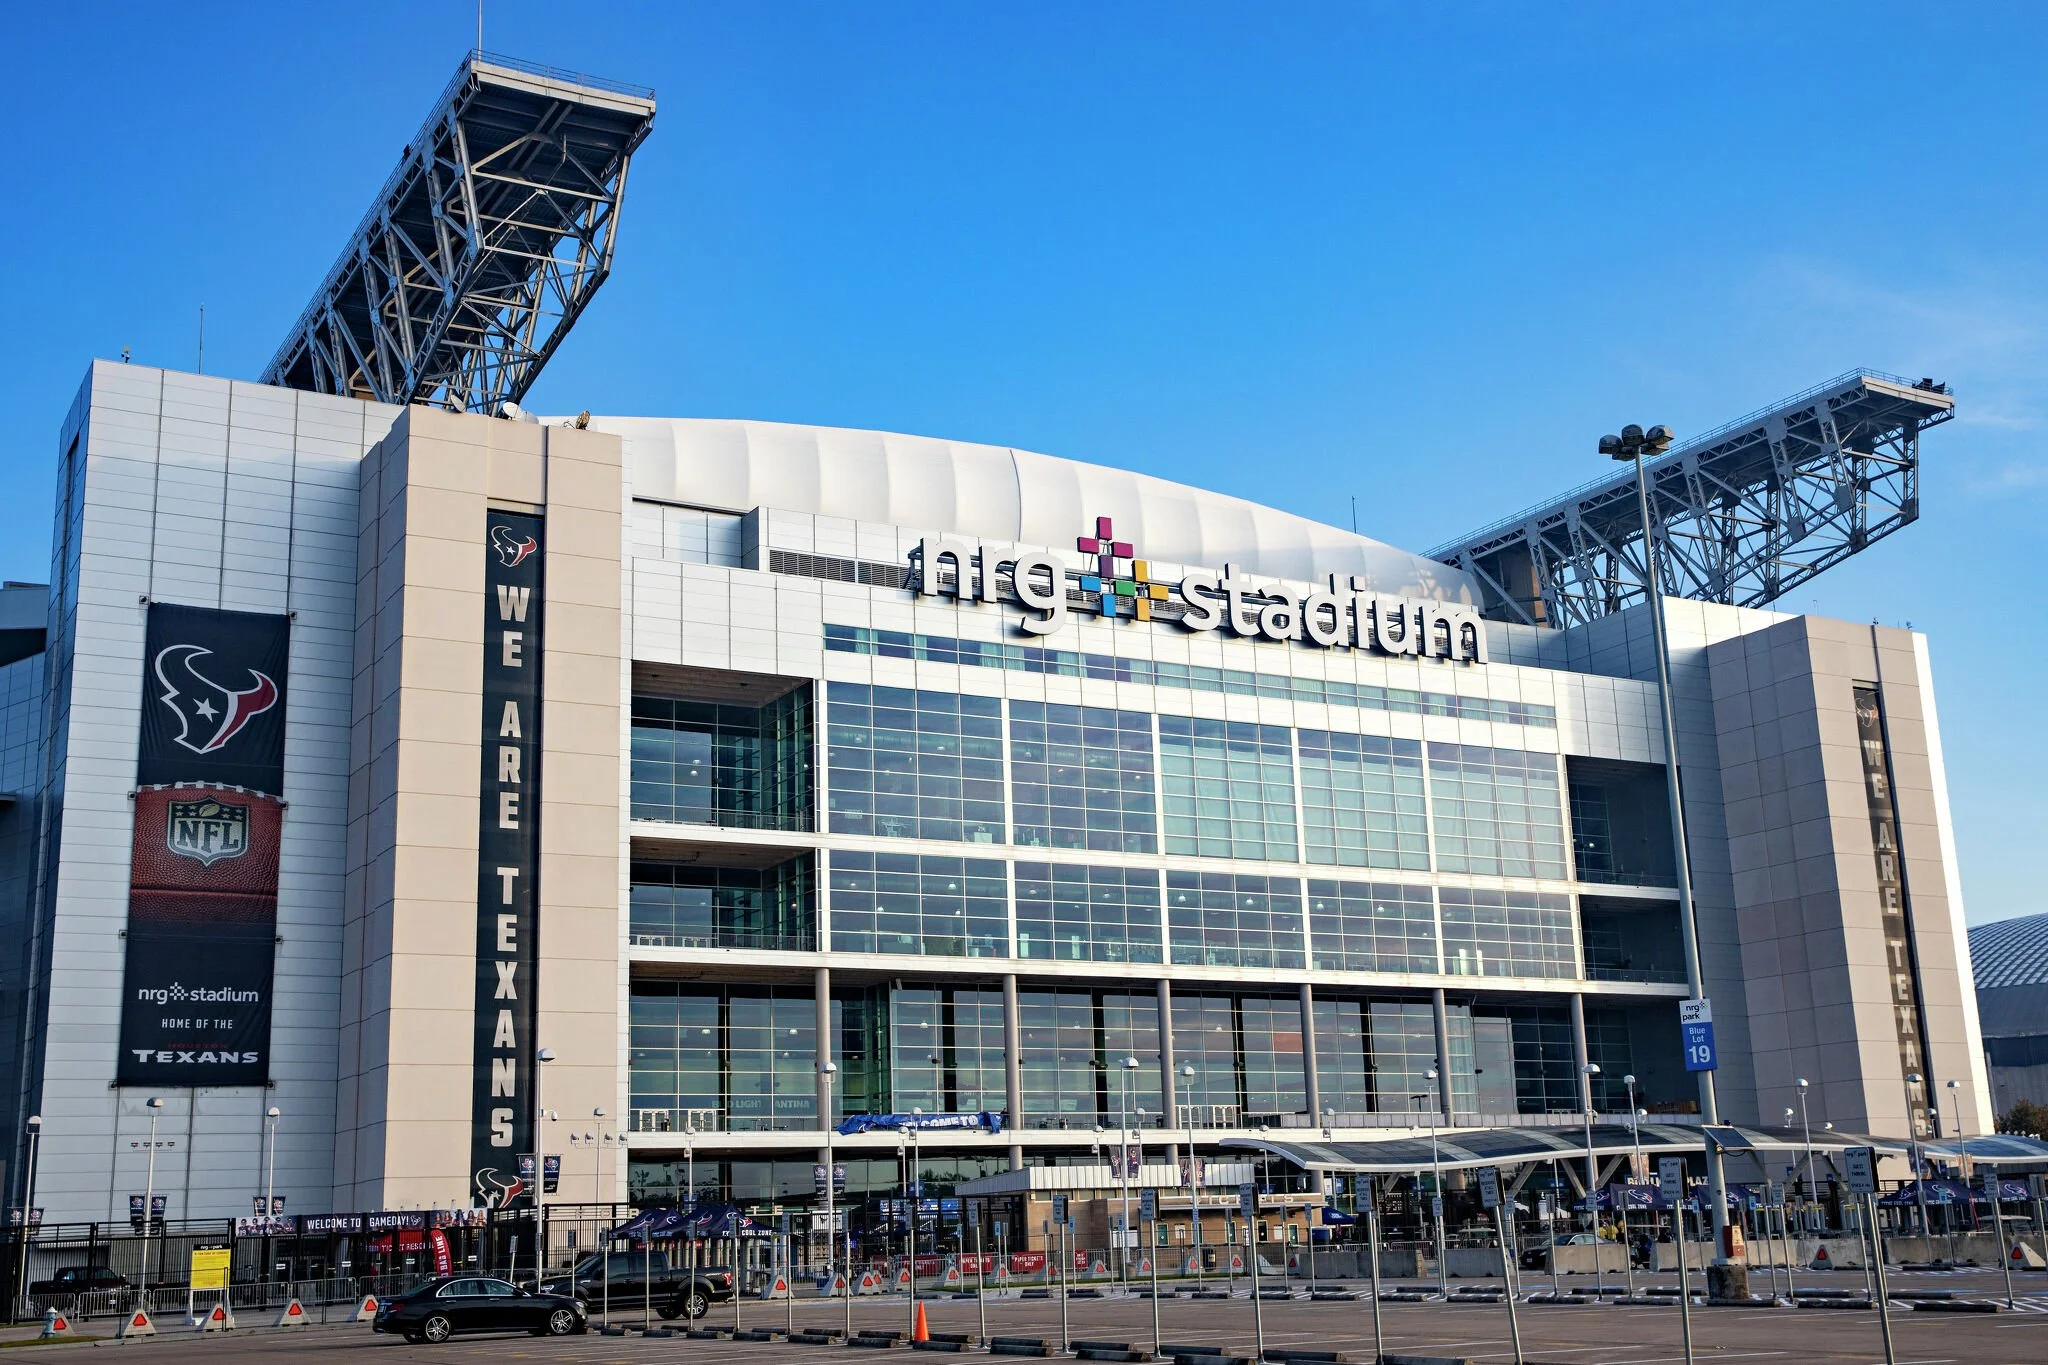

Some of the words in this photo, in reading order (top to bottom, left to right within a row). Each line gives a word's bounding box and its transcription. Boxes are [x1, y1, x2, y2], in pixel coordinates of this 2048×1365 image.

[917, 536, 1065, 636] nrg
[1179, 562, 1489, 664] stadium
[497, 584, 531, 668] WE
[499, 700, 522, 831] ARE
[1864, 739, 1885, 799] WE
[1878, 822, 1899, 914] ARE
[177, 820, 239, 852] NFL
[138, 988, 168, 1005] nrg
[190, 987, 259, 1002] stadium
[490, 866, 519, 1148] TEXANS
[1685, 1004, 1700, 1013] nrg
[161, 1018, 190, 1029] HOME
[196, 1018, 209, 1029] OF
[213, 1019, 233, 1029] THE
[1682, 1012, 1701, 1022] park
[1688, 1027, 1706, 1035] Blue
[1692, 1035, 1705, 1043] Lot
[131, 1049, 259, 1064] TEXANS
[1688, 1045, 1711, 1064] 19
[772, 1099, 810, 1109] ANTINA
[307, 1217, 348, 1231] WELCOME
[350, 1217, 361, 1228] TO
[369, 1215, 409, 1228] GAMEDAY!
